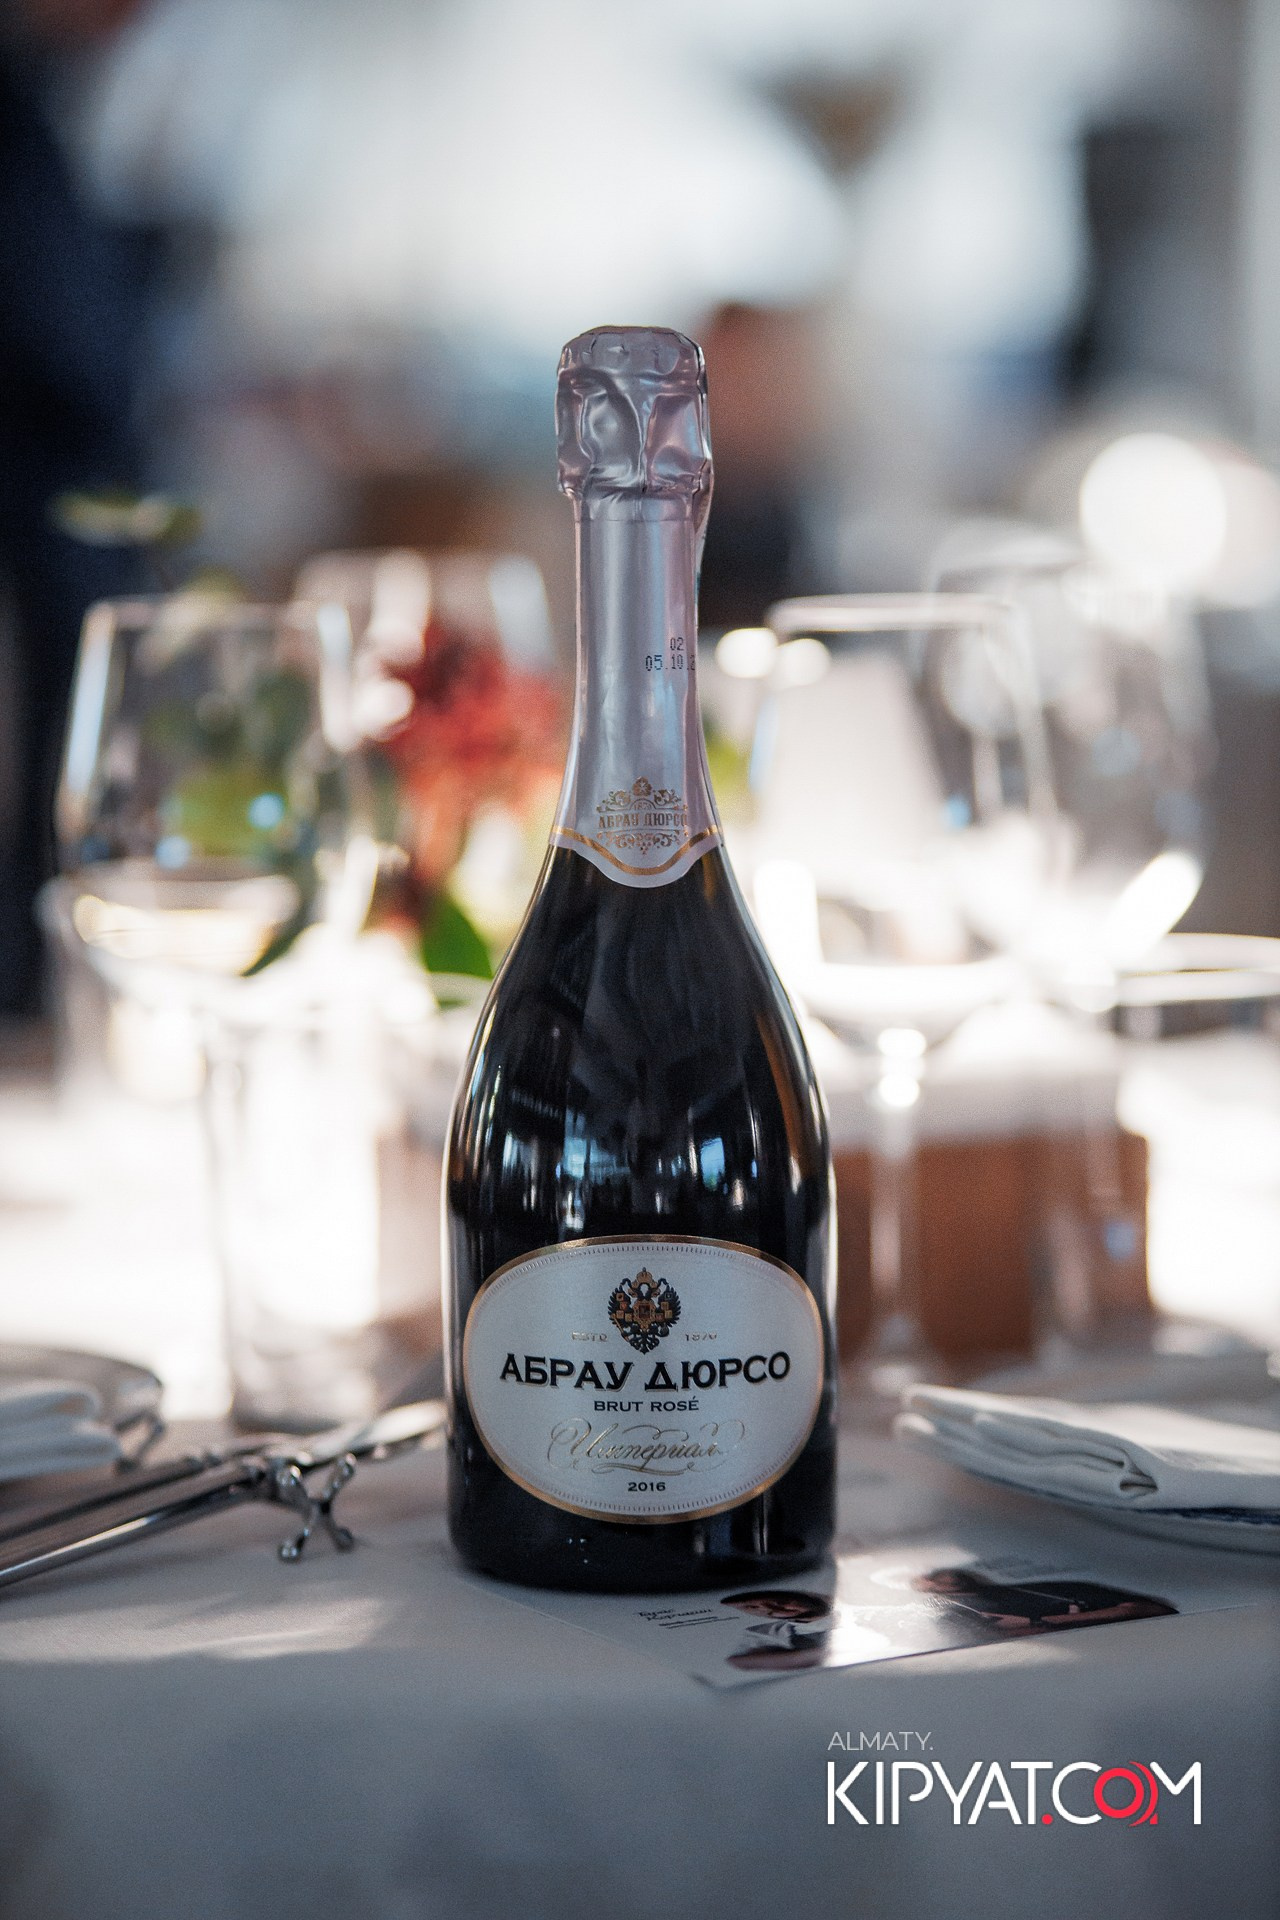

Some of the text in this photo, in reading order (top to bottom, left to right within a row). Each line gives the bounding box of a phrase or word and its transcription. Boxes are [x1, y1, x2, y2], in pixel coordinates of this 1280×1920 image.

[669, 636, 684, 651] 02
[598, 812, 688, 829] АБРАУ ДЮРСО
[499, 1351, 792, 1393] АБРАУ ДЮРСО
[593, 1396, 700, 1412] BRUT ROSÉ
[627, 1481, 666, 1493] 2016
